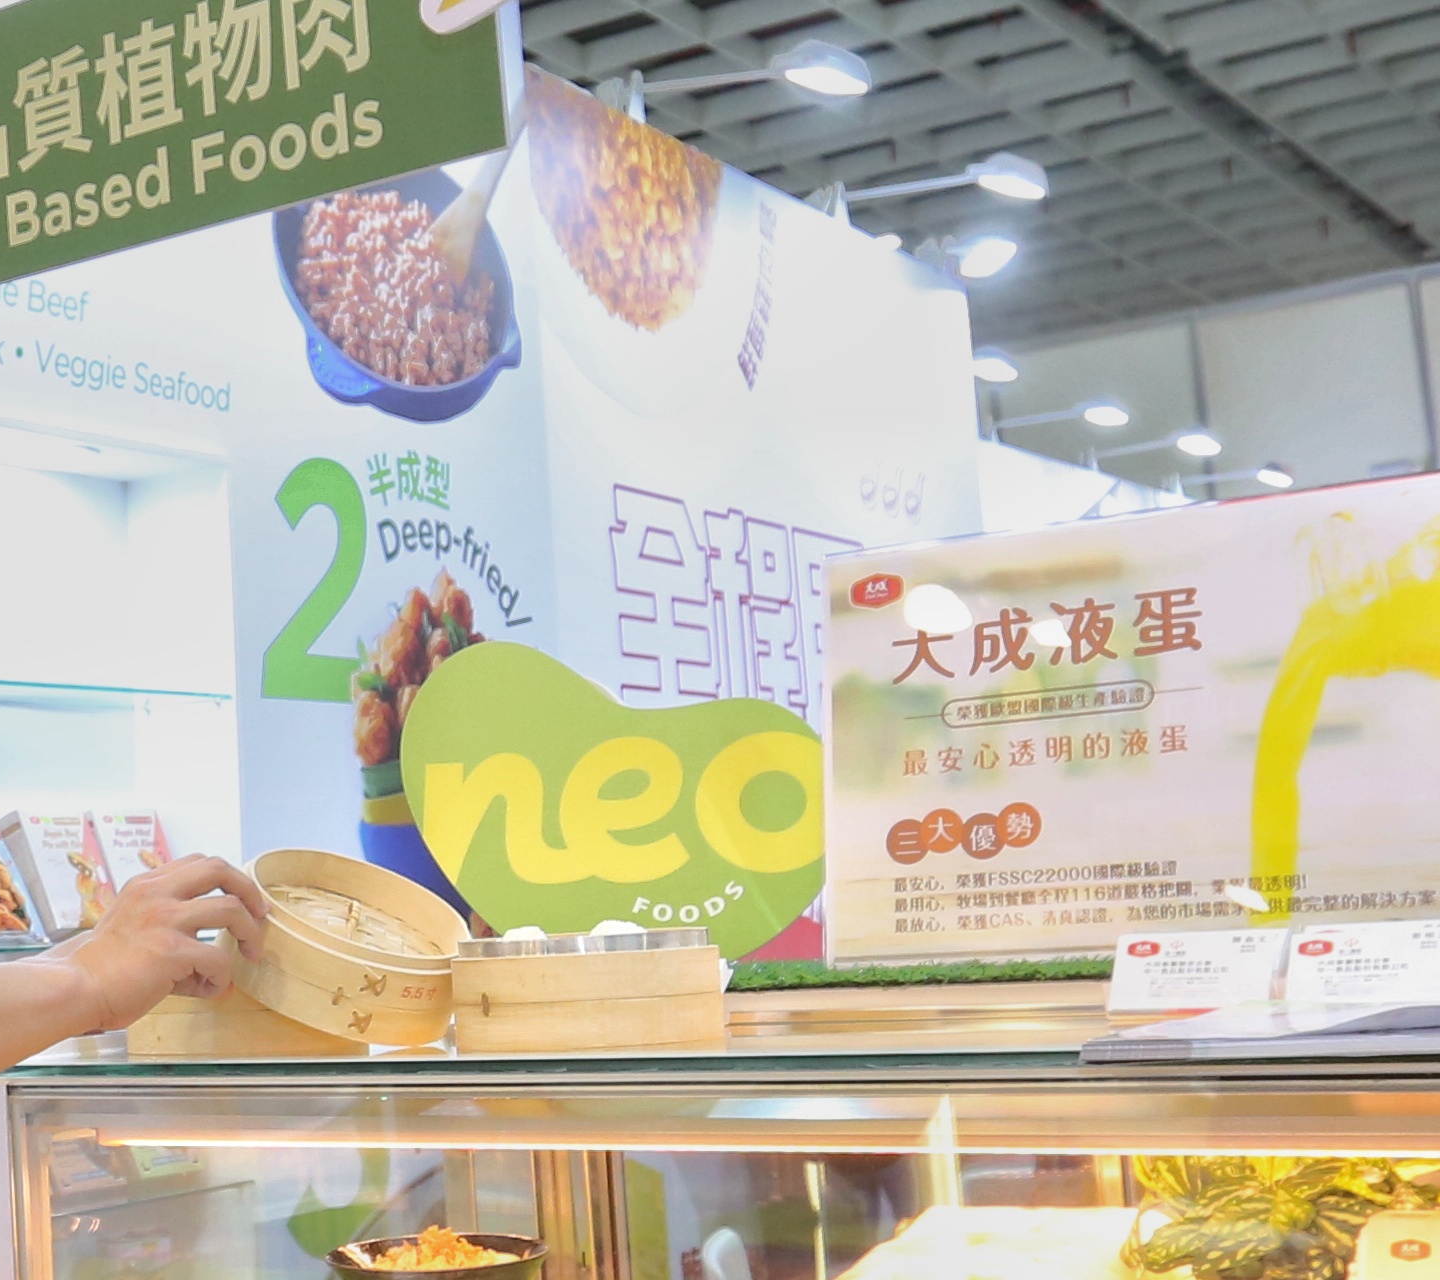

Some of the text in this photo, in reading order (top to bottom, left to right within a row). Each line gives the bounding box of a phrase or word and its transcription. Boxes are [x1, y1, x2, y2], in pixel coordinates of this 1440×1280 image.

[7, 148, 171, 249] Based
[192, 92, 384, 196] Foods
[27, 279, 91, 323] Beef
[35, 339, 127, 392] Veggie
[133, 360, 232, 412] Seafood
[367, 450, 450, 510] 半成型
[261, 457, 367, 702] 2
[891, 586, 1204, 686] 大成液蛋
[903, 725, 1190, 778] 最安心透明的液蛋
[423, 730, 825, 885] neo
[896, 811, 1035, 856] 三大優勢
[632, 880, 745, 924] FOODS
